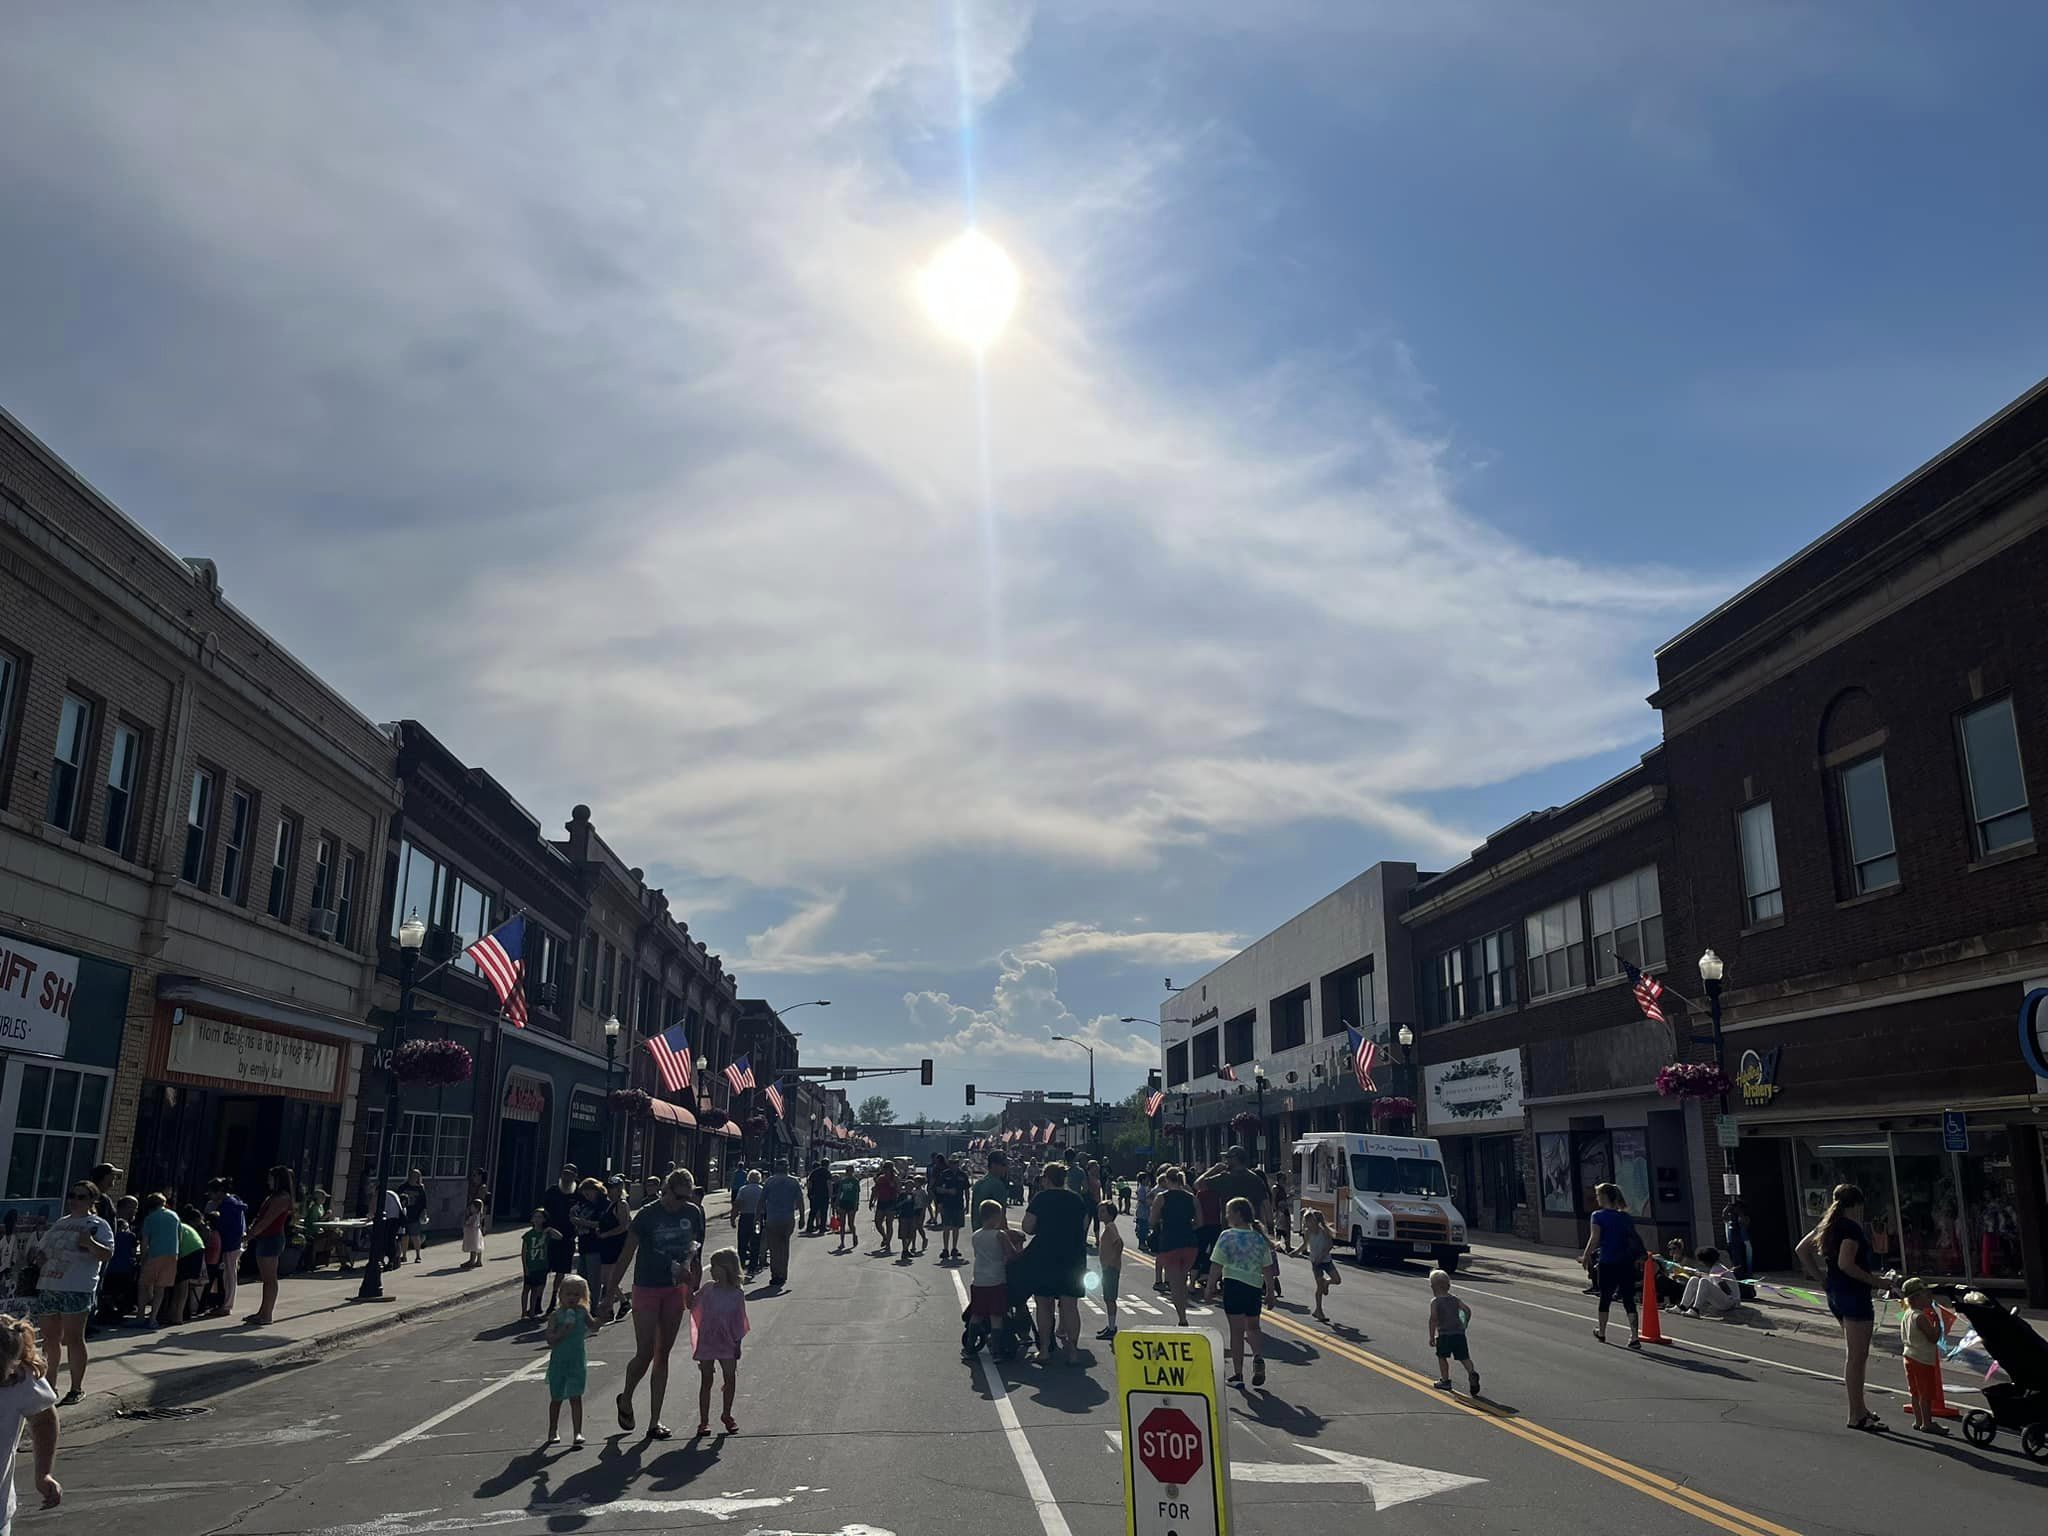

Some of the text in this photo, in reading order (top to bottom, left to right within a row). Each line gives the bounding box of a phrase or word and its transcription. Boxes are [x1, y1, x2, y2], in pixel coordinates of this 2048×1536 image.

[0, 946, 37, 998] IFT
[257, 1037, 273, 1053] and
[238, 1058, 249, 1079] by
[1132, 1340, 1193, 1362] STATE
[1143, 1365, 1185, 1387] LAW
[1143, 1431, 1199, 1461] STOP
[1158, 1502, 1190, 1520] FOR
